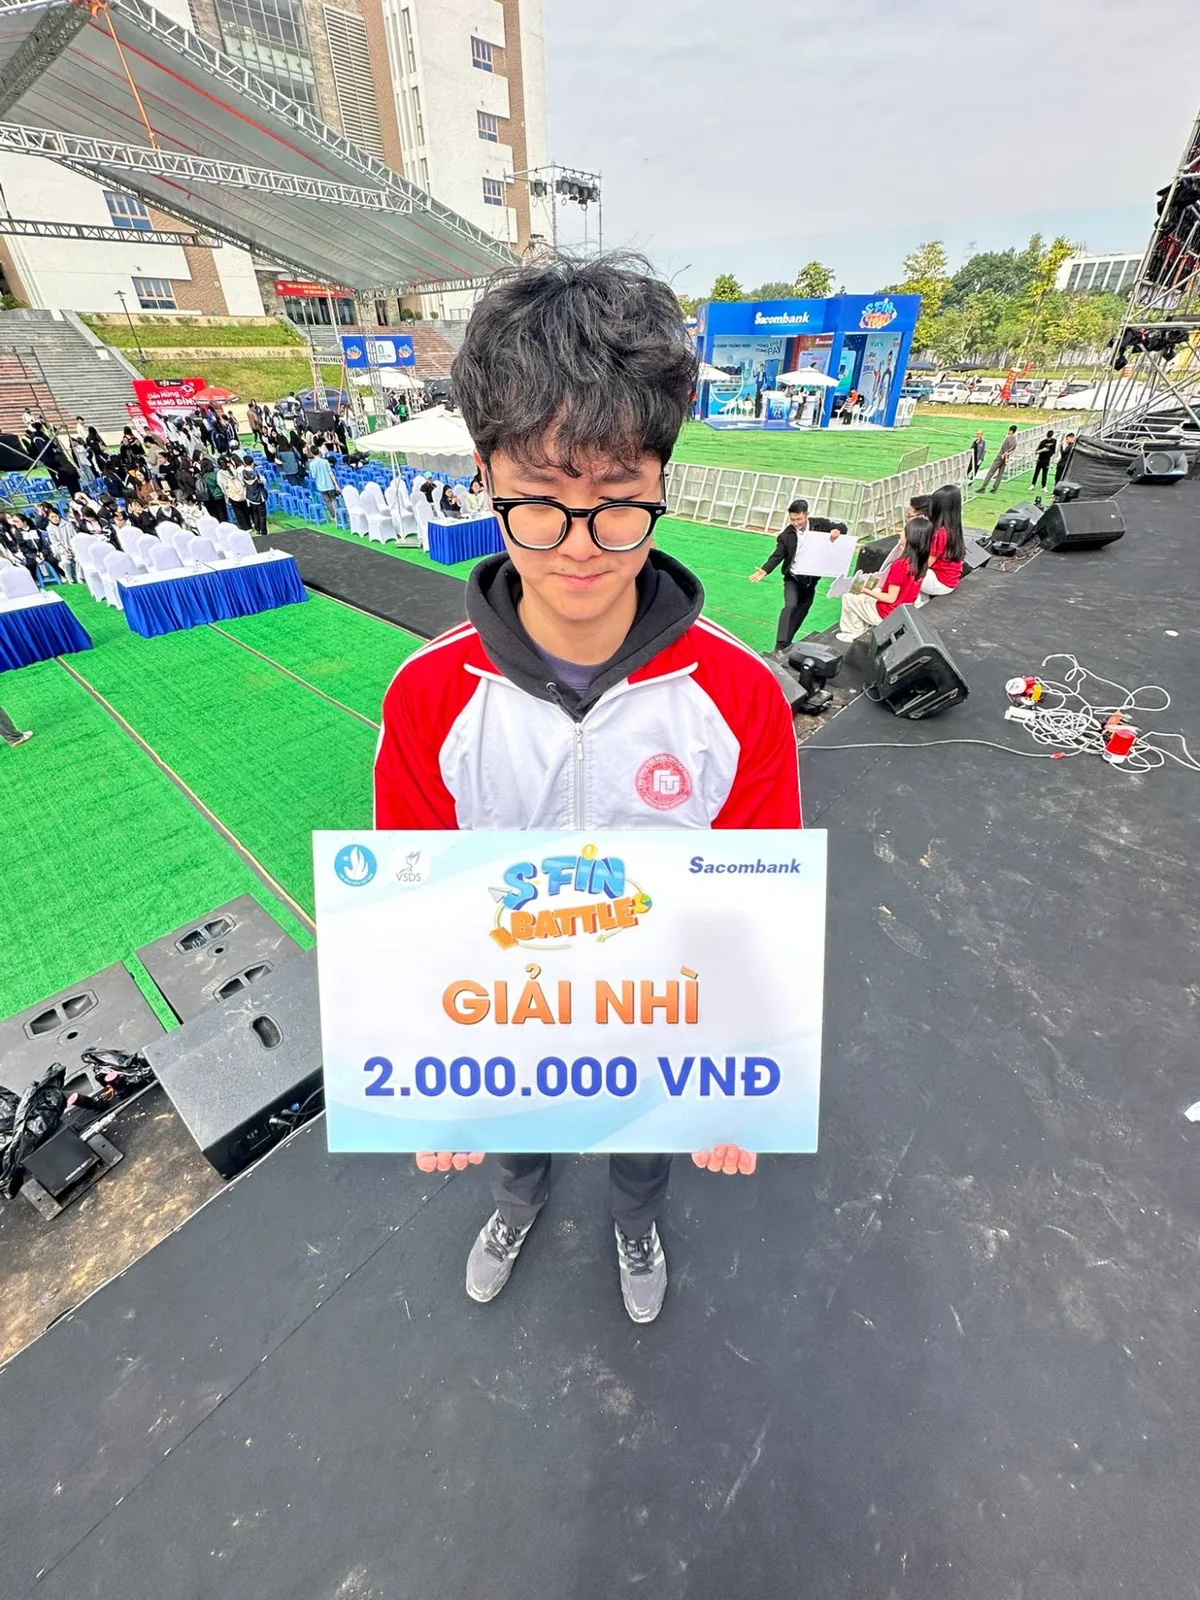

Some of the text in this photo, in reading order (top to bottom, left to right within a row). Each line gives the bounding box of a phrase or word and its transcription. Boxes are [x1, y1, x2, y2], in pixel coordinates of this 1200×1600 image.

[754, 311, 810, 325] Sacombank
[395, 872, 421, 882] VSDS
[688, 856, 802, 874] Sacombank
[510, 897, 639, 941] BATTLE
[442, 963, 699, 1025] GIẢI NHÌ
[363, 1055, 782, 1098] 2.000.000 VNĐ
